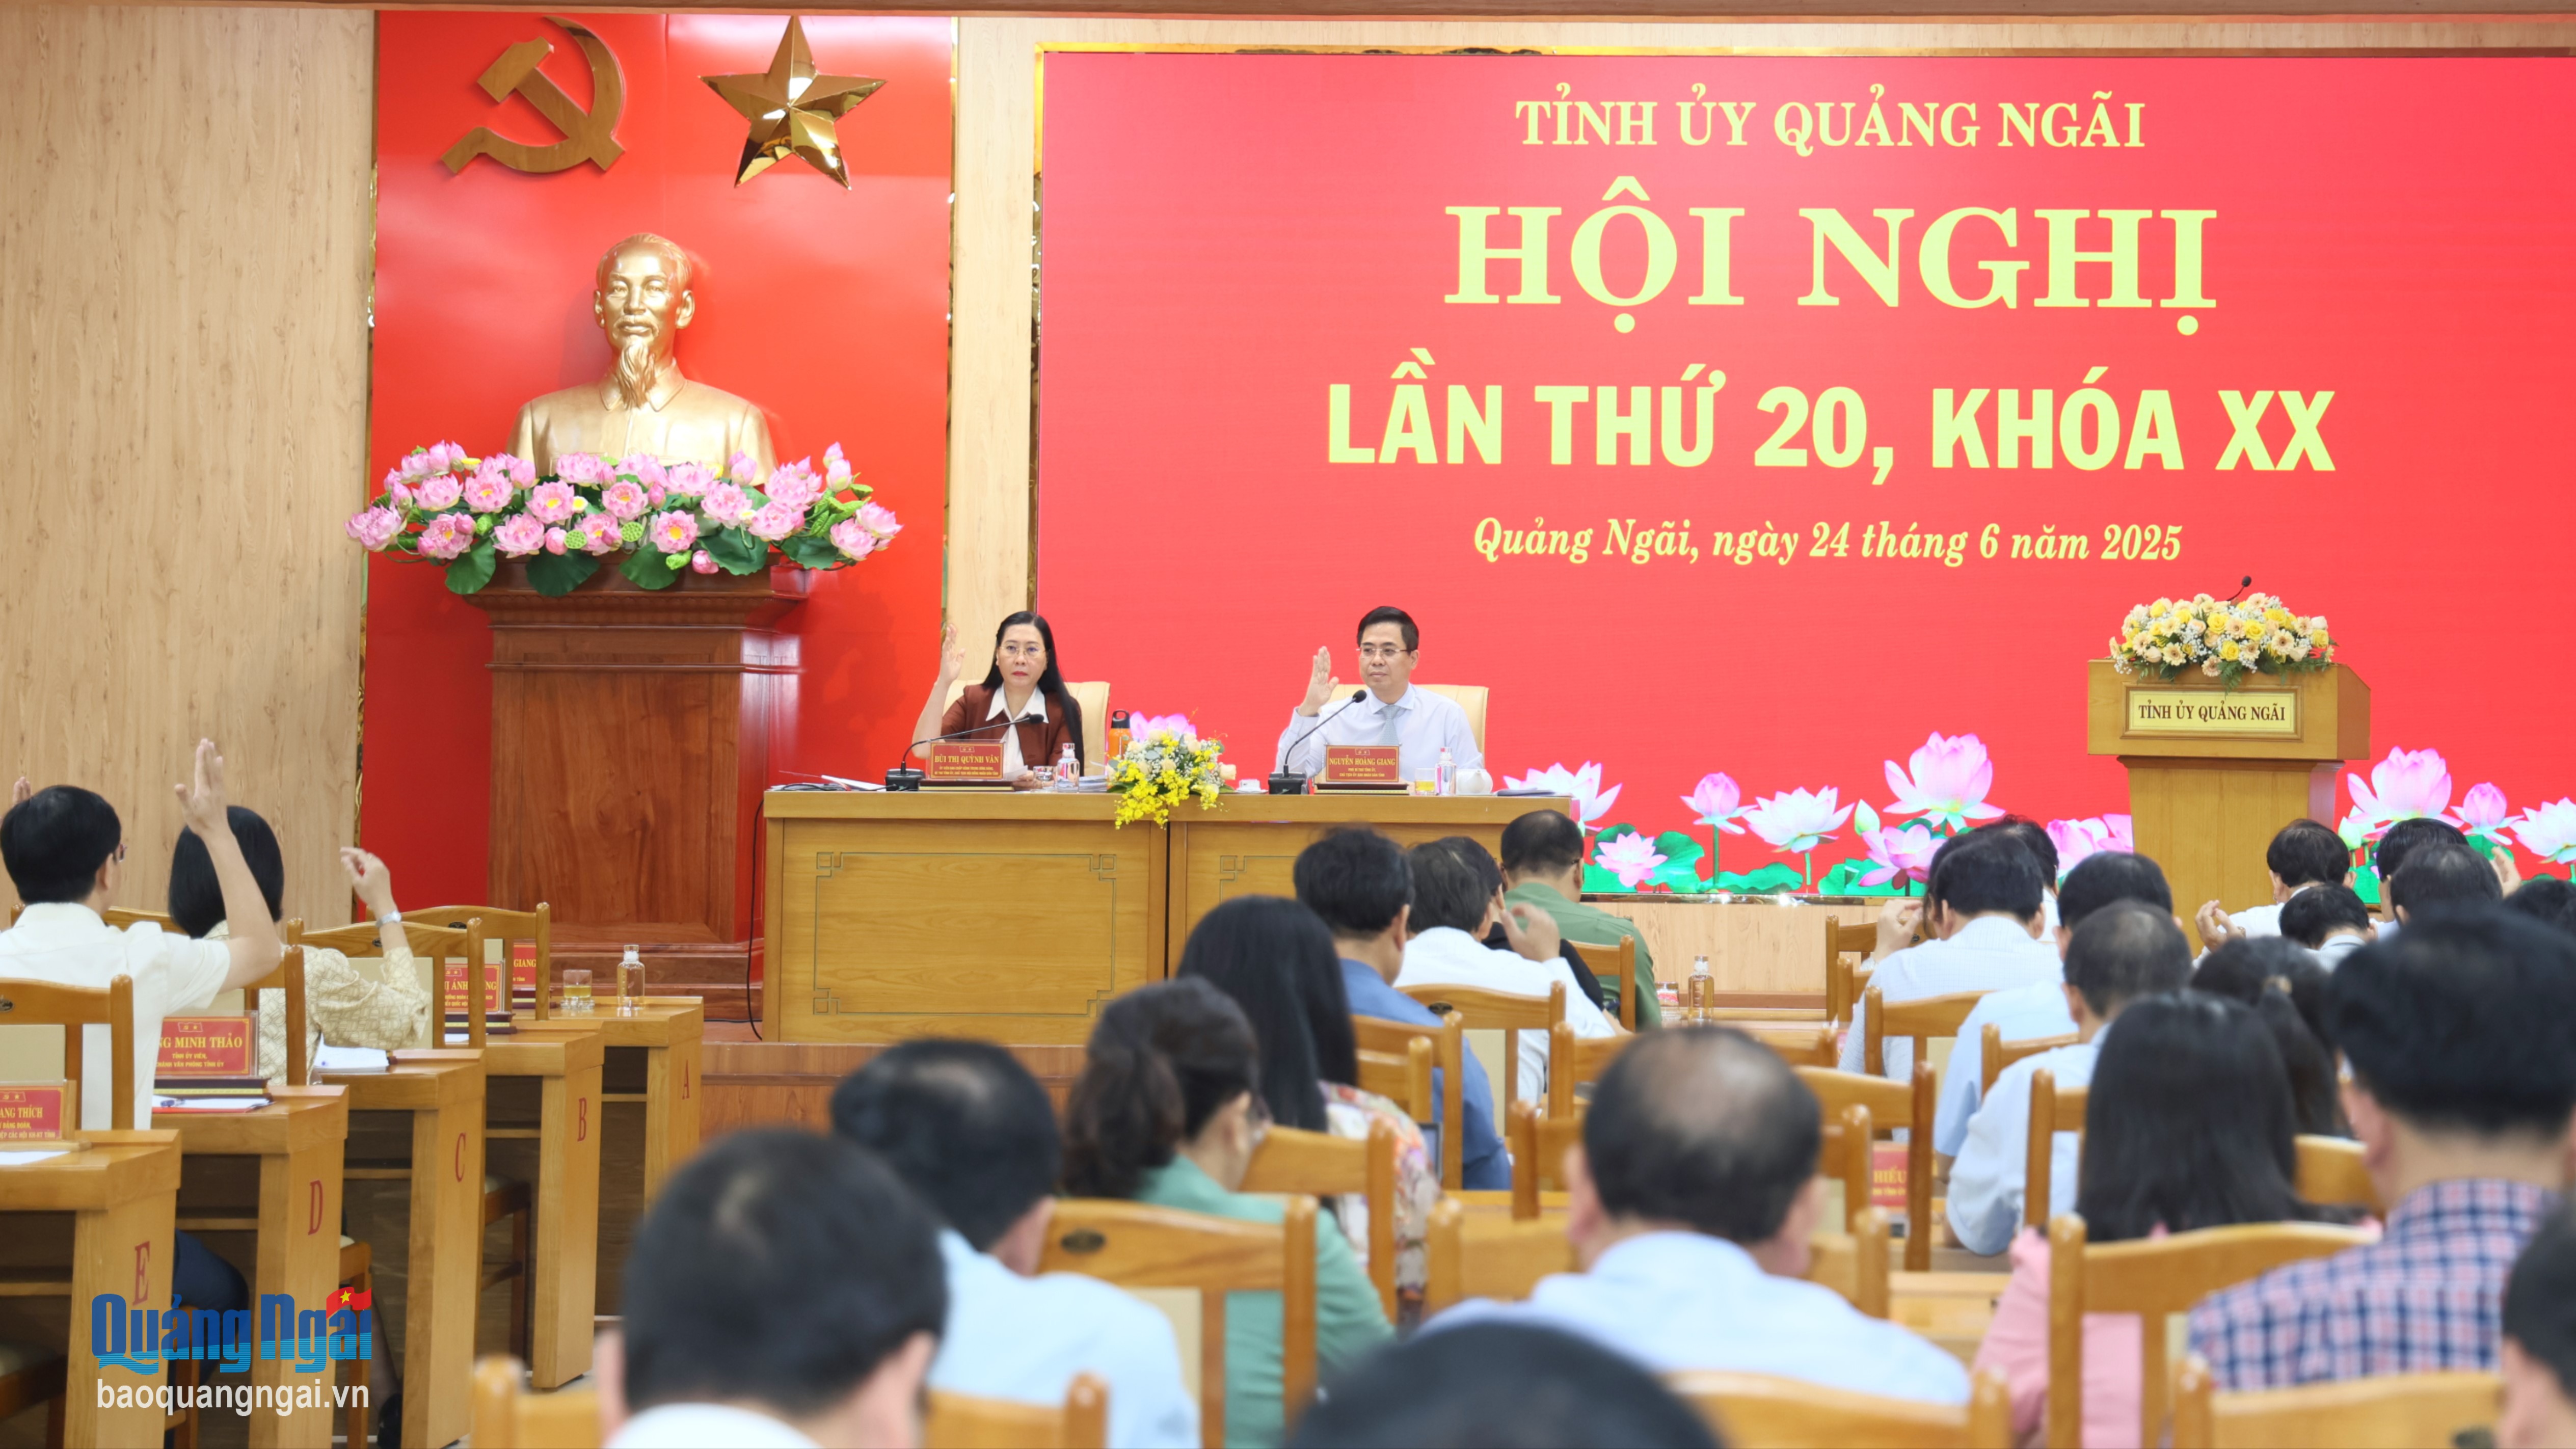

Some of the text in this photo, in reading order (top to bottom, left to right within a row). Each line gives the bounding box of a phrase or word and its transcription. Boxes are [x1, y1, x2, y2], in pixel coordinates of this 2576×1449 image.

[1515, 83, 2145, 157] TỈNH ỦY QUẢNG NGÃI
[1444, 176, 2217, 335] HỘI NGHỊ
[1329, 348, 2335, 485] LẦN THỨ 20, KHÓA XX
[1473, 517, 2183, 567] Quảng Ngãi, ngày 24 tháng 6 năm 2025
[2138, 700, 2286, 722] TỈNH ỦY QUẢNG NGÃI
[934, 754, 947, 763] BÙI
[948, 755, 959, 764] THỊ
[1329, 755, 1396, 766] NGUYỄN HOÀNG GIANG
[451, 978, 468, 990] ÁNH
[514, 958, 536, 968] GIANG
[175, 1037, 206, 1049] MINH
[209, 1032, 243, 1049] THẢO
[682, 1059, 690, 1100] A
[0, 1104, 43, 1118] ANG THÍCH
[577, 1097, 587, 1142] B
[454, 1132, 467, 1183] C
[307, 1179, 324, 1236] D
[132, 1241, 150, 1306] E
